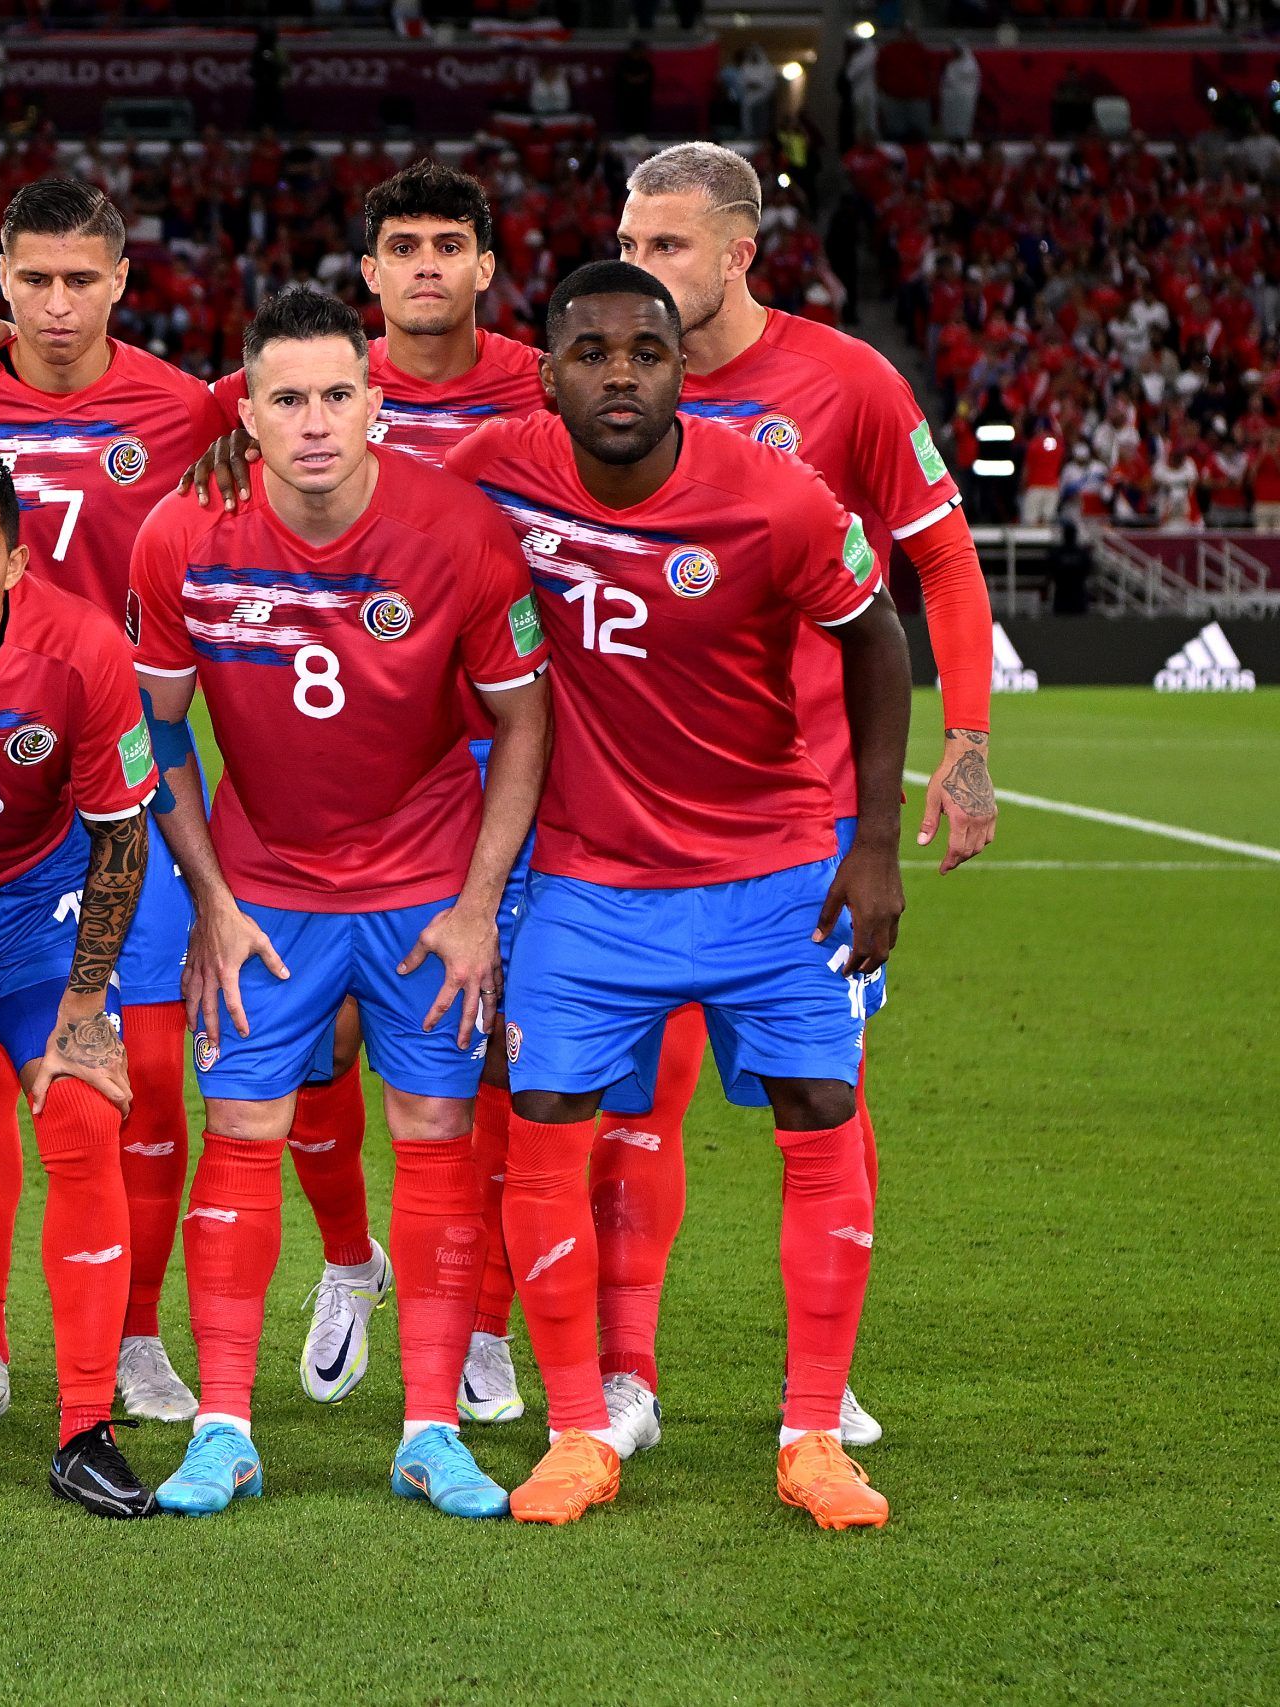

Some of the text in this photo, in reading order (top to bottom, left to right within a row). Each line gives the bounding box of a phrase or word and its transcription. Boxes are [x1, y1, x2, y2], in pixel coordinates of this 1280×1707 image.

[105, 60, 162, 85] CUP
[39, 489, 84, 562] 7
[563, 580, 648, 658] 12
[294, 645, 345, 719] 8
[1153, 668, 1256, 693] adidas
